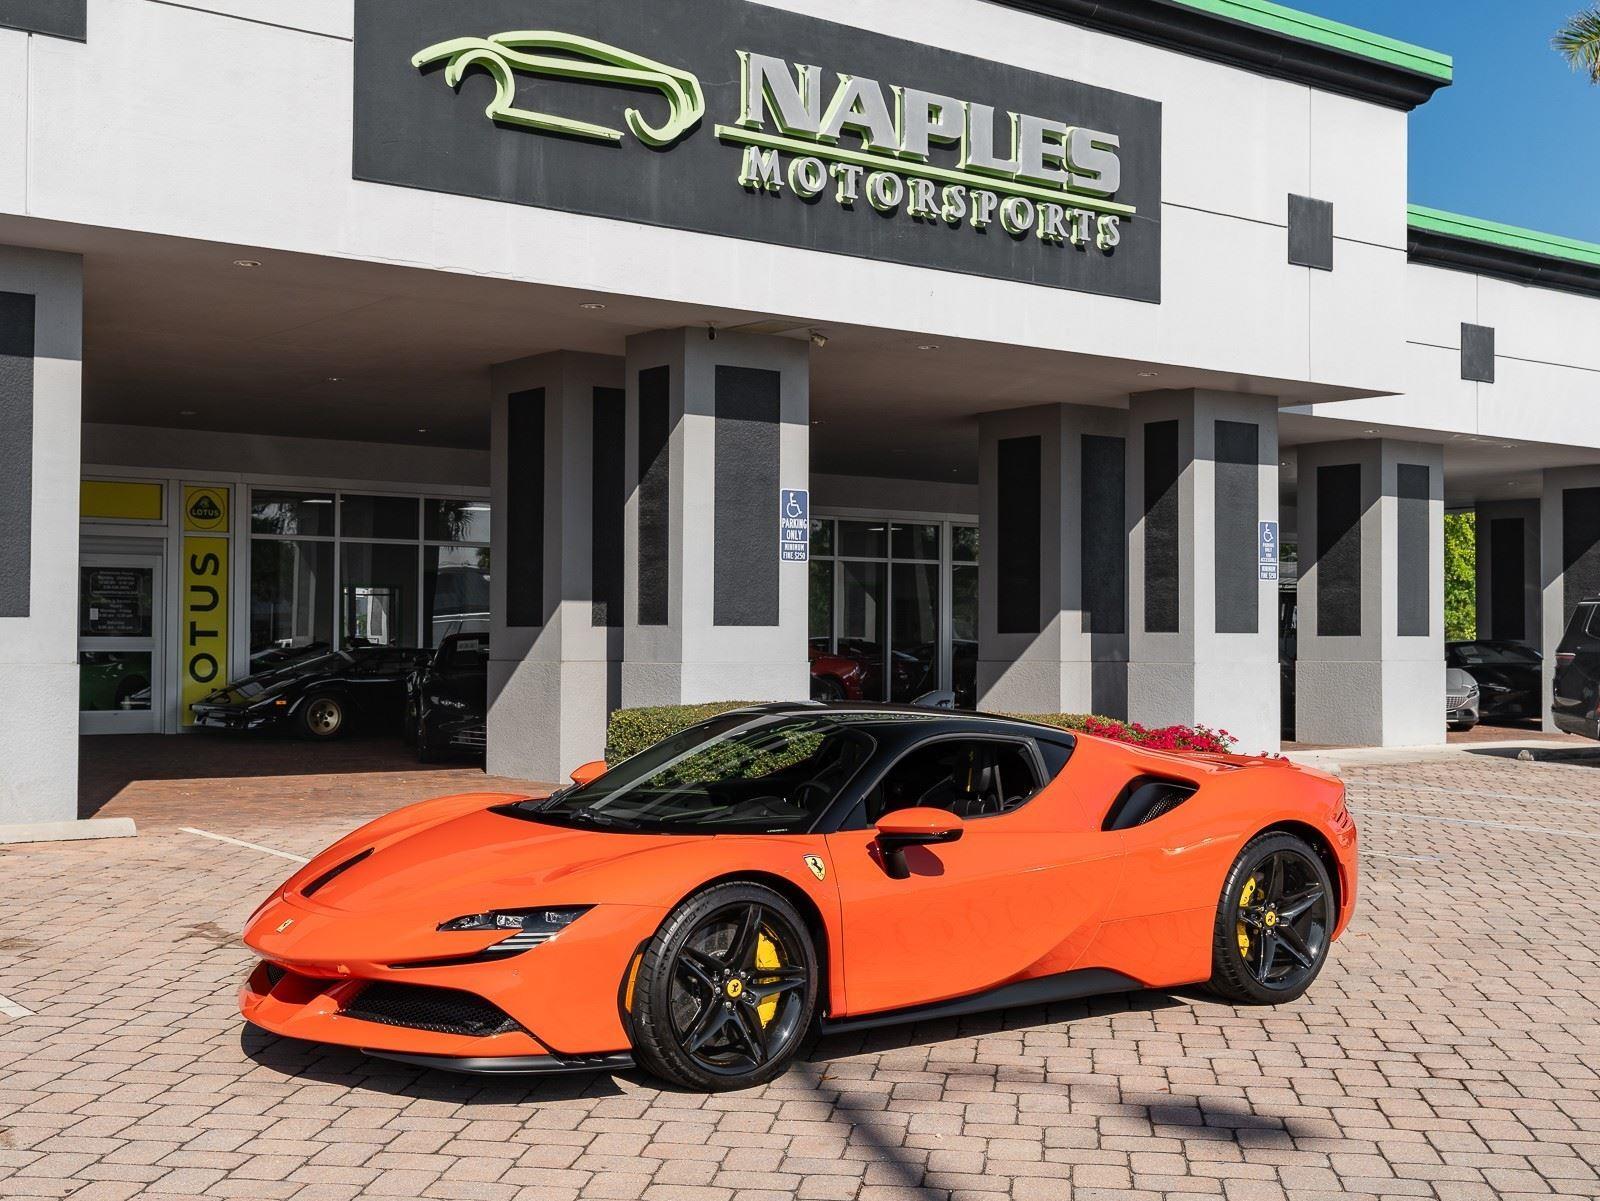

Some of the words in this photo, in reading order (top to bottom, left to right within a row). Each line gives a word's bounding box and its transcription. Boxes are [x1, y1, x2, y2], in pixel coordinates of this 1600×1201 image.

[736, 50, 1121, 196] NAPLES
[738, 146, 1121, 250] MOTORSPORTS
[782, 518, 807, 529] PARKING
[786, 529, 803, 540] ONLY
[784, 543, 805, 551] MINIMUM
[783, 552, 793, 560] FINE
[794, 552, 806, 560] $250
[189, 552, 220, 711] OTUS
